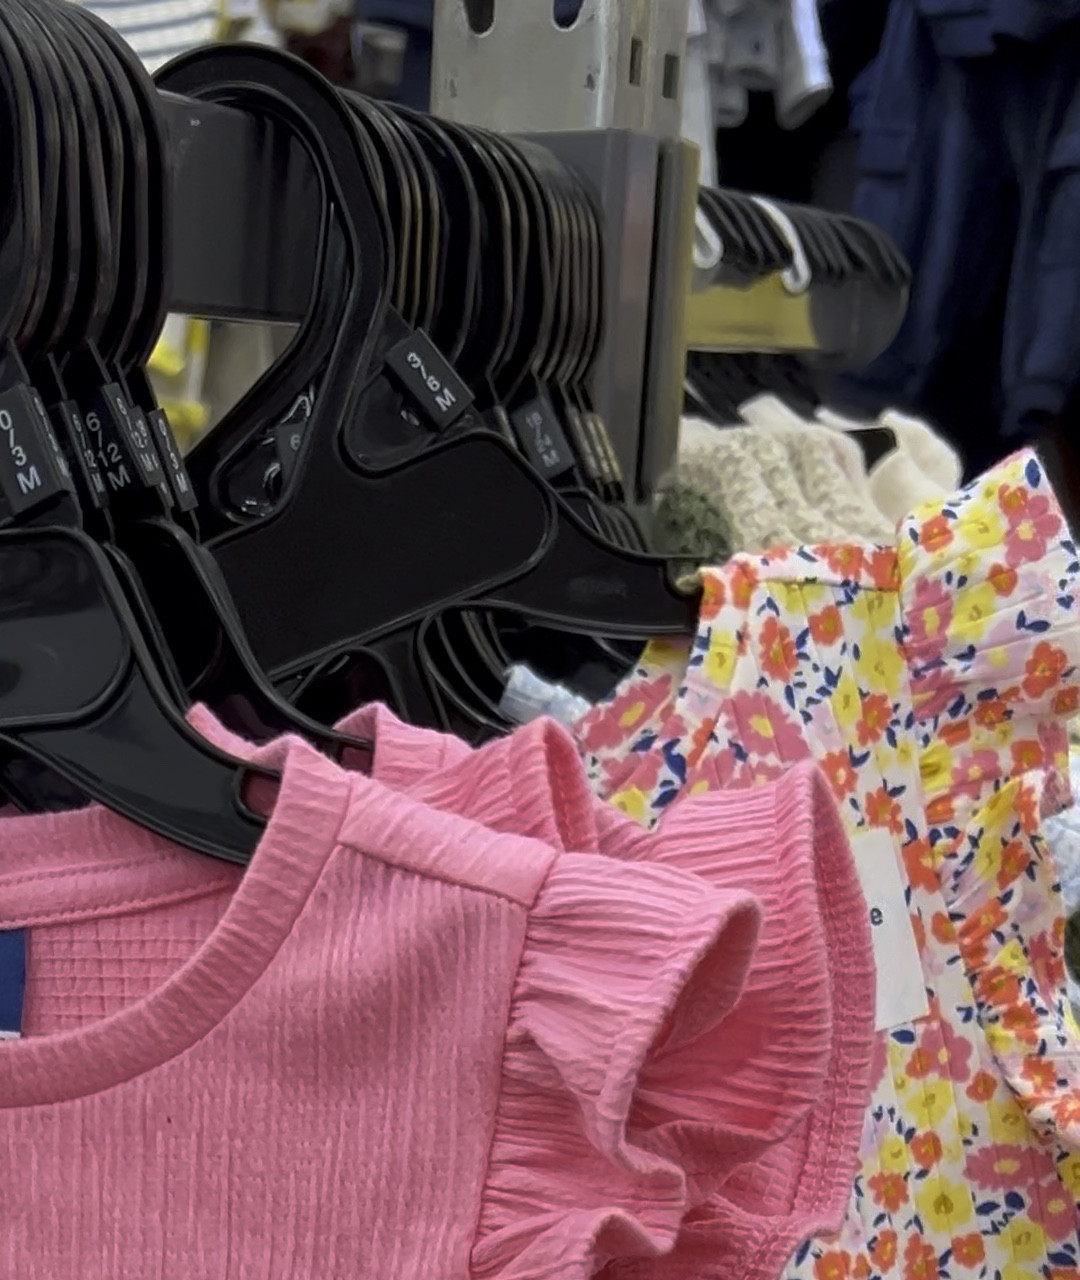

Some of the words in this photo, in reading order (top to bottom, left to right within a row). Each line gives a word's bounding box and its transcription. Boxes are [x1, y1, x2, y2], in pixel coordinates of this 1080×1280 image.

[435, 387, 456, 412] M
[16, 465, 42, 494] M
[107, 464, 131, 491] M
